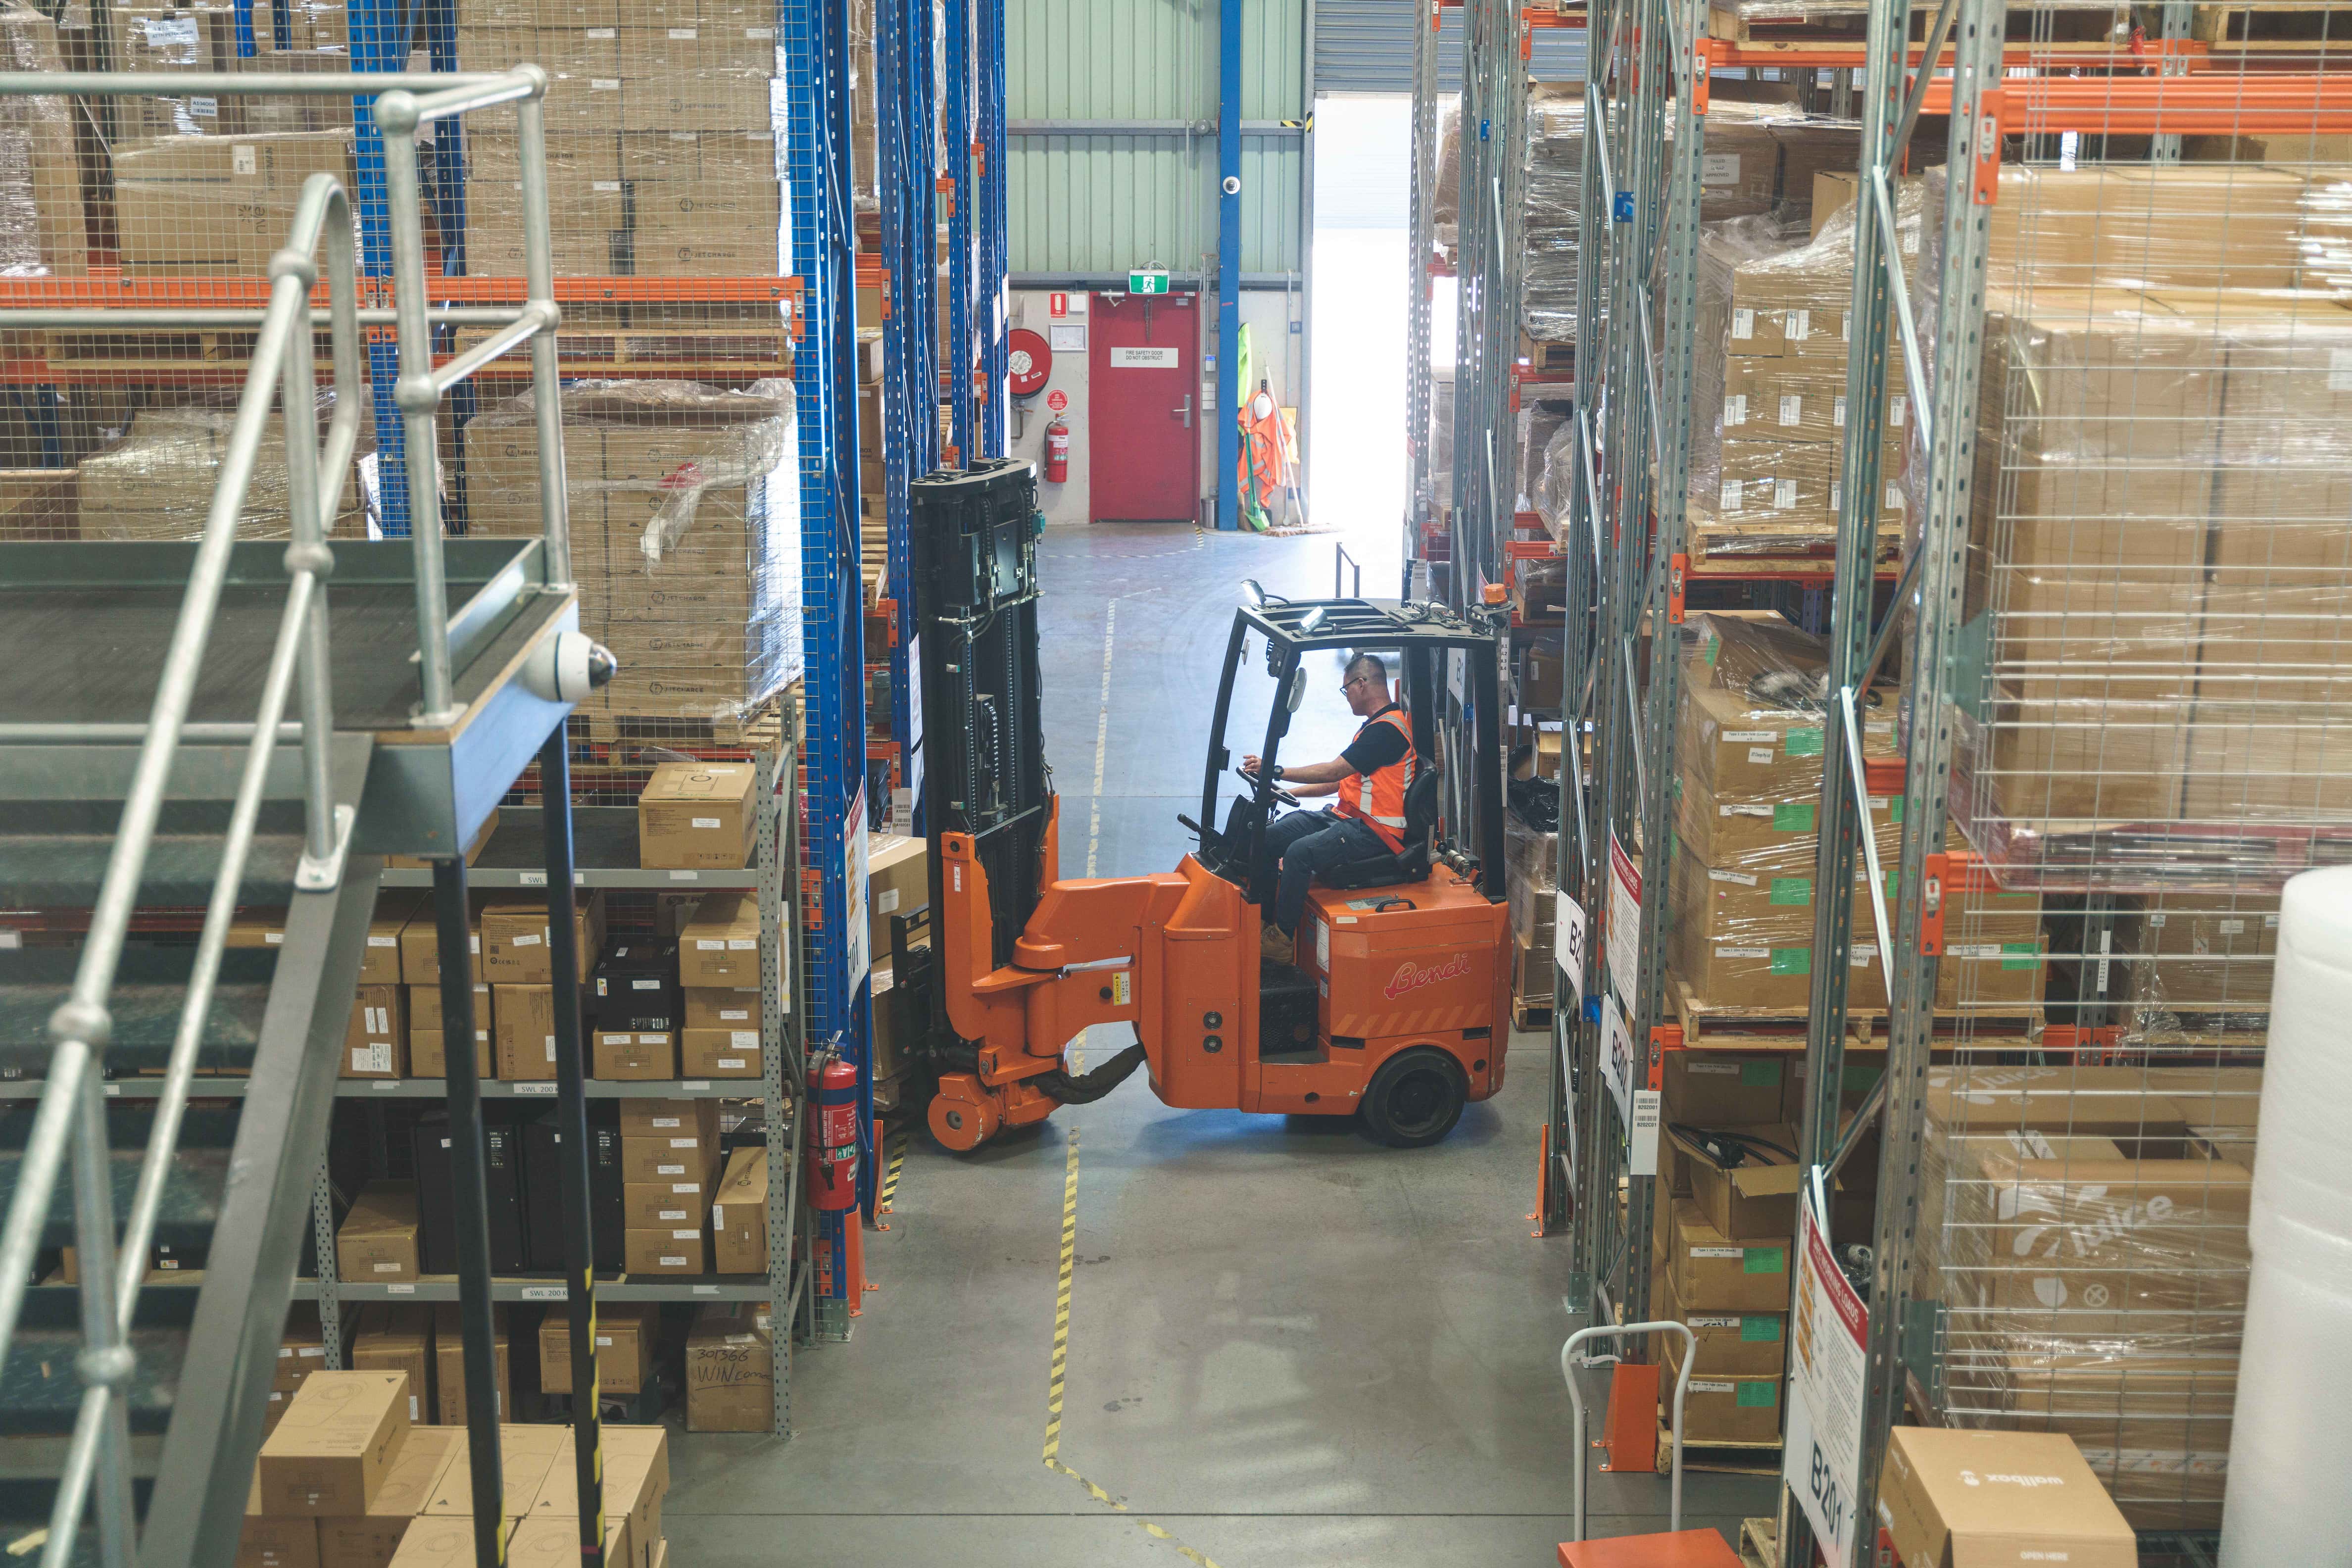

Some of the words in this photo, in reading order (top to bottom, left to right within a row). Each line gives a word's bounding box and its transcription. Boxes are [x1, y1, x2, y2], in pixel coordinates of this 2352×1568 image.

[1628, 870, 1638, 889] LOADS
[1384, 953, 1471, 1000] Bendi
[1612, 1029, 1628, 1097] B202
[1821, 1252, 1841, 1295] WORKING
[1841, 1291, 1859, 1323] LOADS
[697, 1349, 750, 1362] 301366
[697, 1363, 735, 1382] WIN
[1985, 1473, 2064, 1487] wallbox
[1811, 1439, 1842, 1553] B201
[2020, 1551, 2043, 1561] OPEN
[2044, 1552, 2068, 1561] HERE
